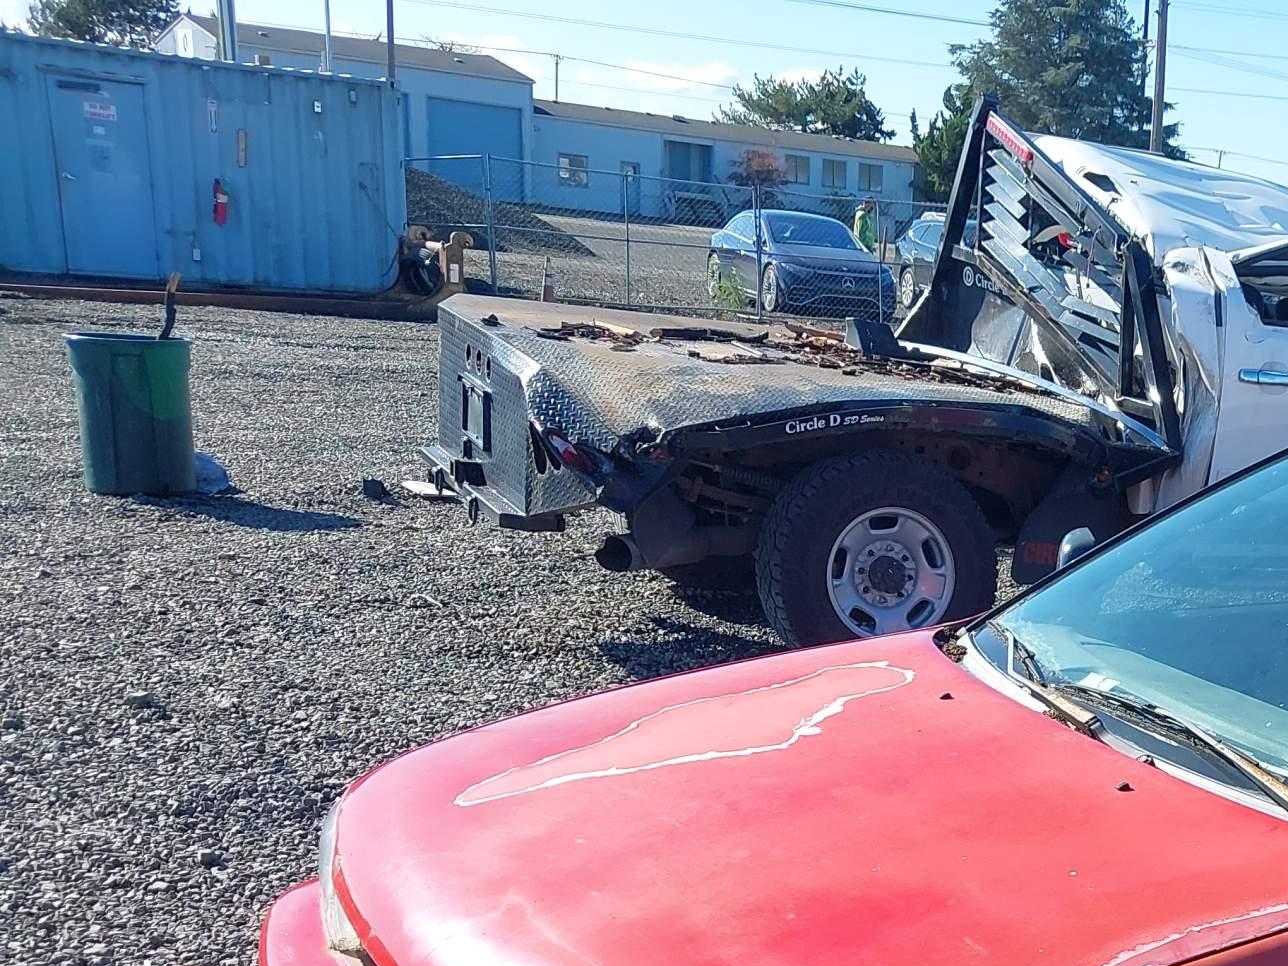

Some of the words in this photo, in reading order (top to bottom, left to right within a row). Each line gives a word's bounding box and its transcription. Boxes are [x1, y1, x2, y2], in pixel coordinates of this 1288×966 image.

[785, 416, 826, 434] Circle
[829, 414, 841, 427] D
[843, 415, 859, 425] SD
[860, 414, 885, 424] Series
